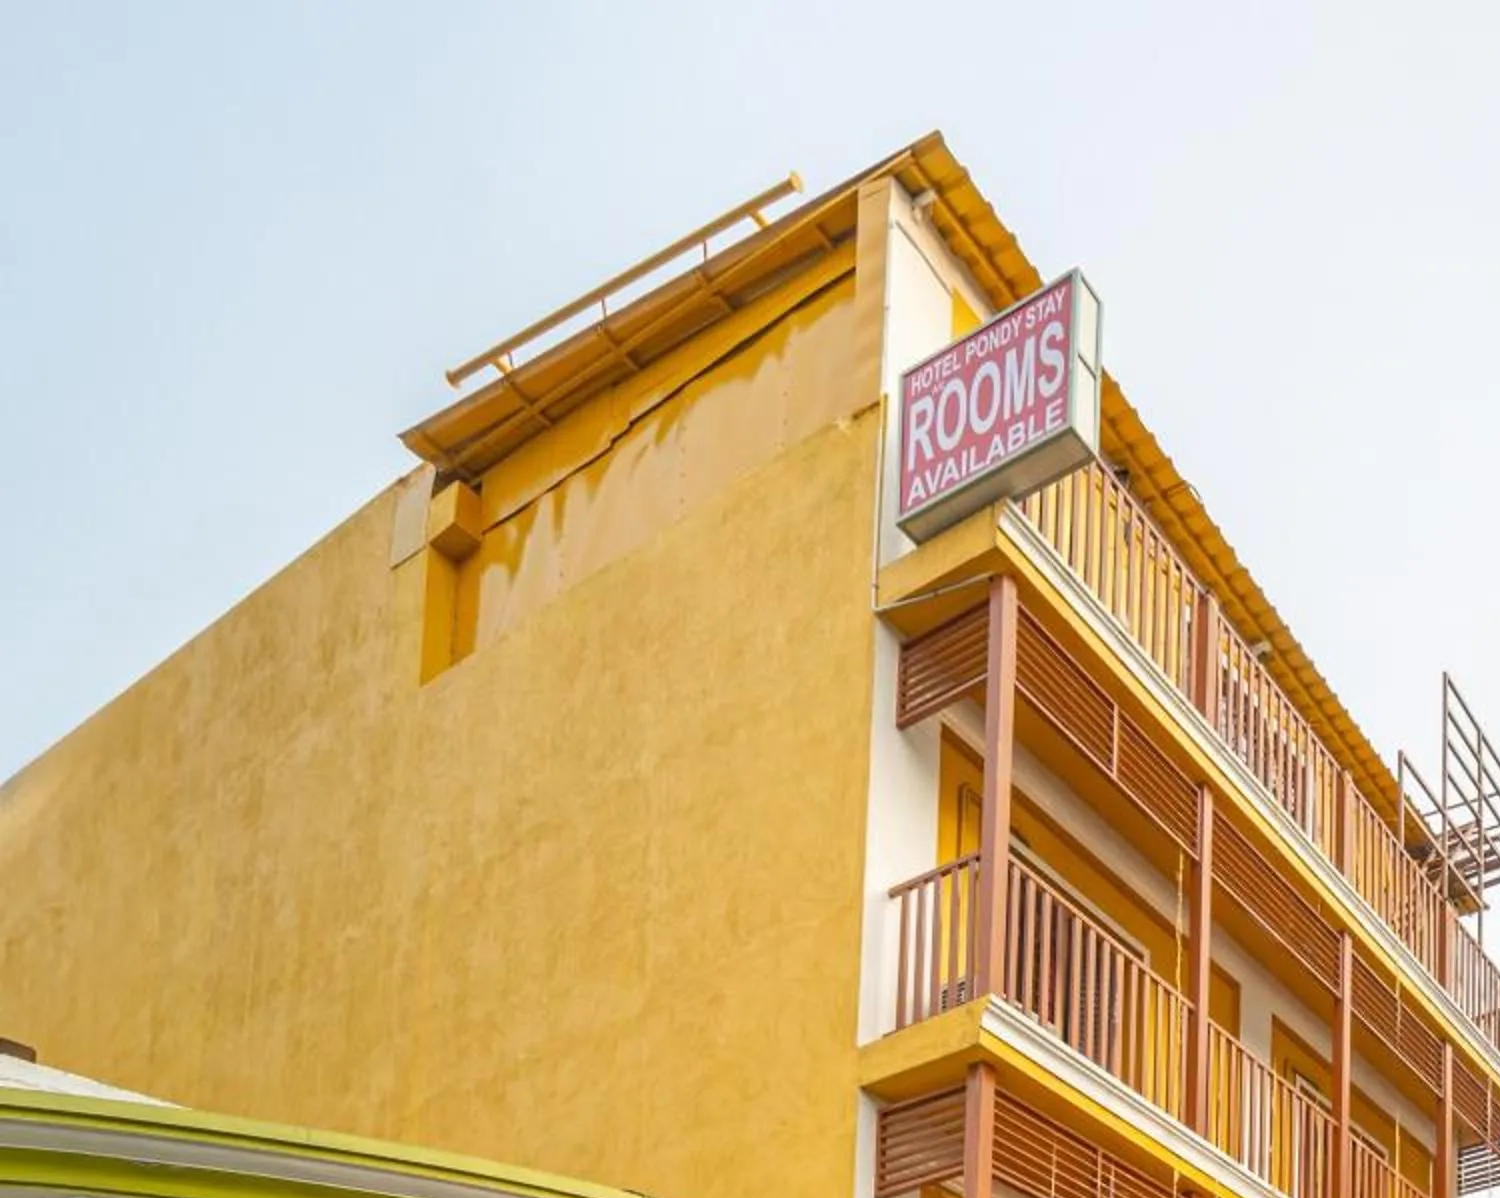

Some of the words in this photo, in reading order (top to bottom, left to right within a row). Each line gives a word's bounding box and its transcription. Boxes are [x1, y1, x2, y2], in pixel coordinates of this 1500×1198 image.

[908, 321, 1064, 470] ROOMS
[911, 353, 960, 395] HOTEL
[965, 316, 1022, 364] PONDY
[1026, 288, 1066, 328] STAY
[907, 398, 1063, 507] AVAILABLE
